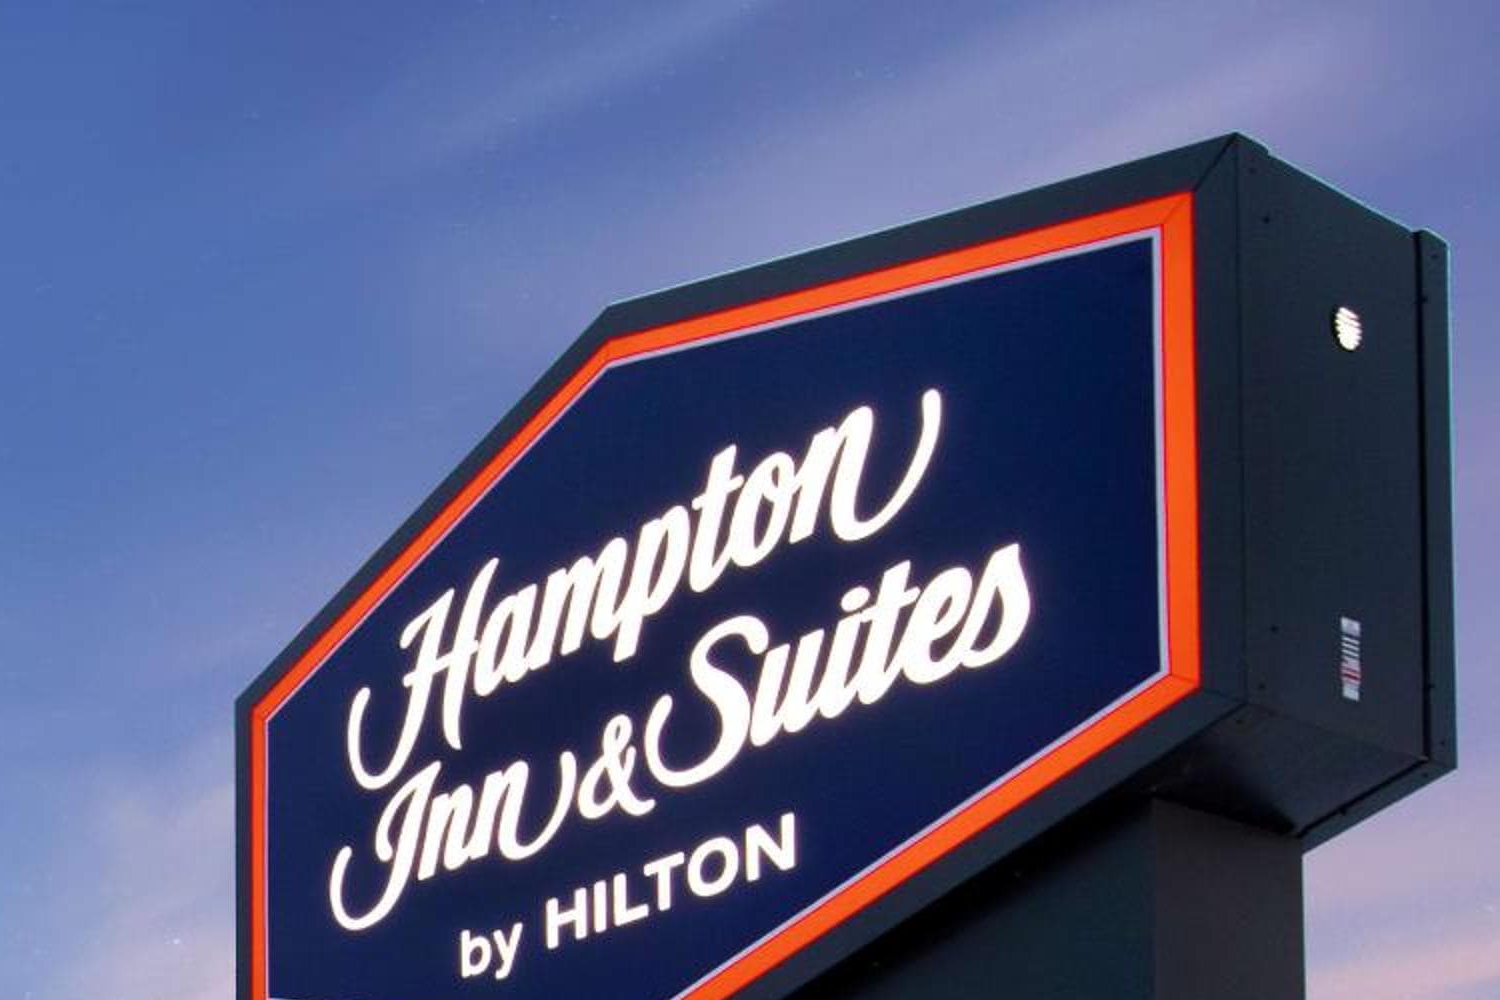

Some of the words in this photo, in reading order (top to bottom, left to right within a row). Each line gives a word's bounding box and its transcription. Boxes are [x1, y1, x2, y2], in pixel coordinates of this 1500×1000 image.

[329, 752, 577, 931] Inn
[577, 714, 656, 818] &
[645, 543, 1031, 787] Suites
[348, 389, 942, 789] Hampton
[461, 923, 523, 979] by
[546, 812, 795, 949] HILTON
